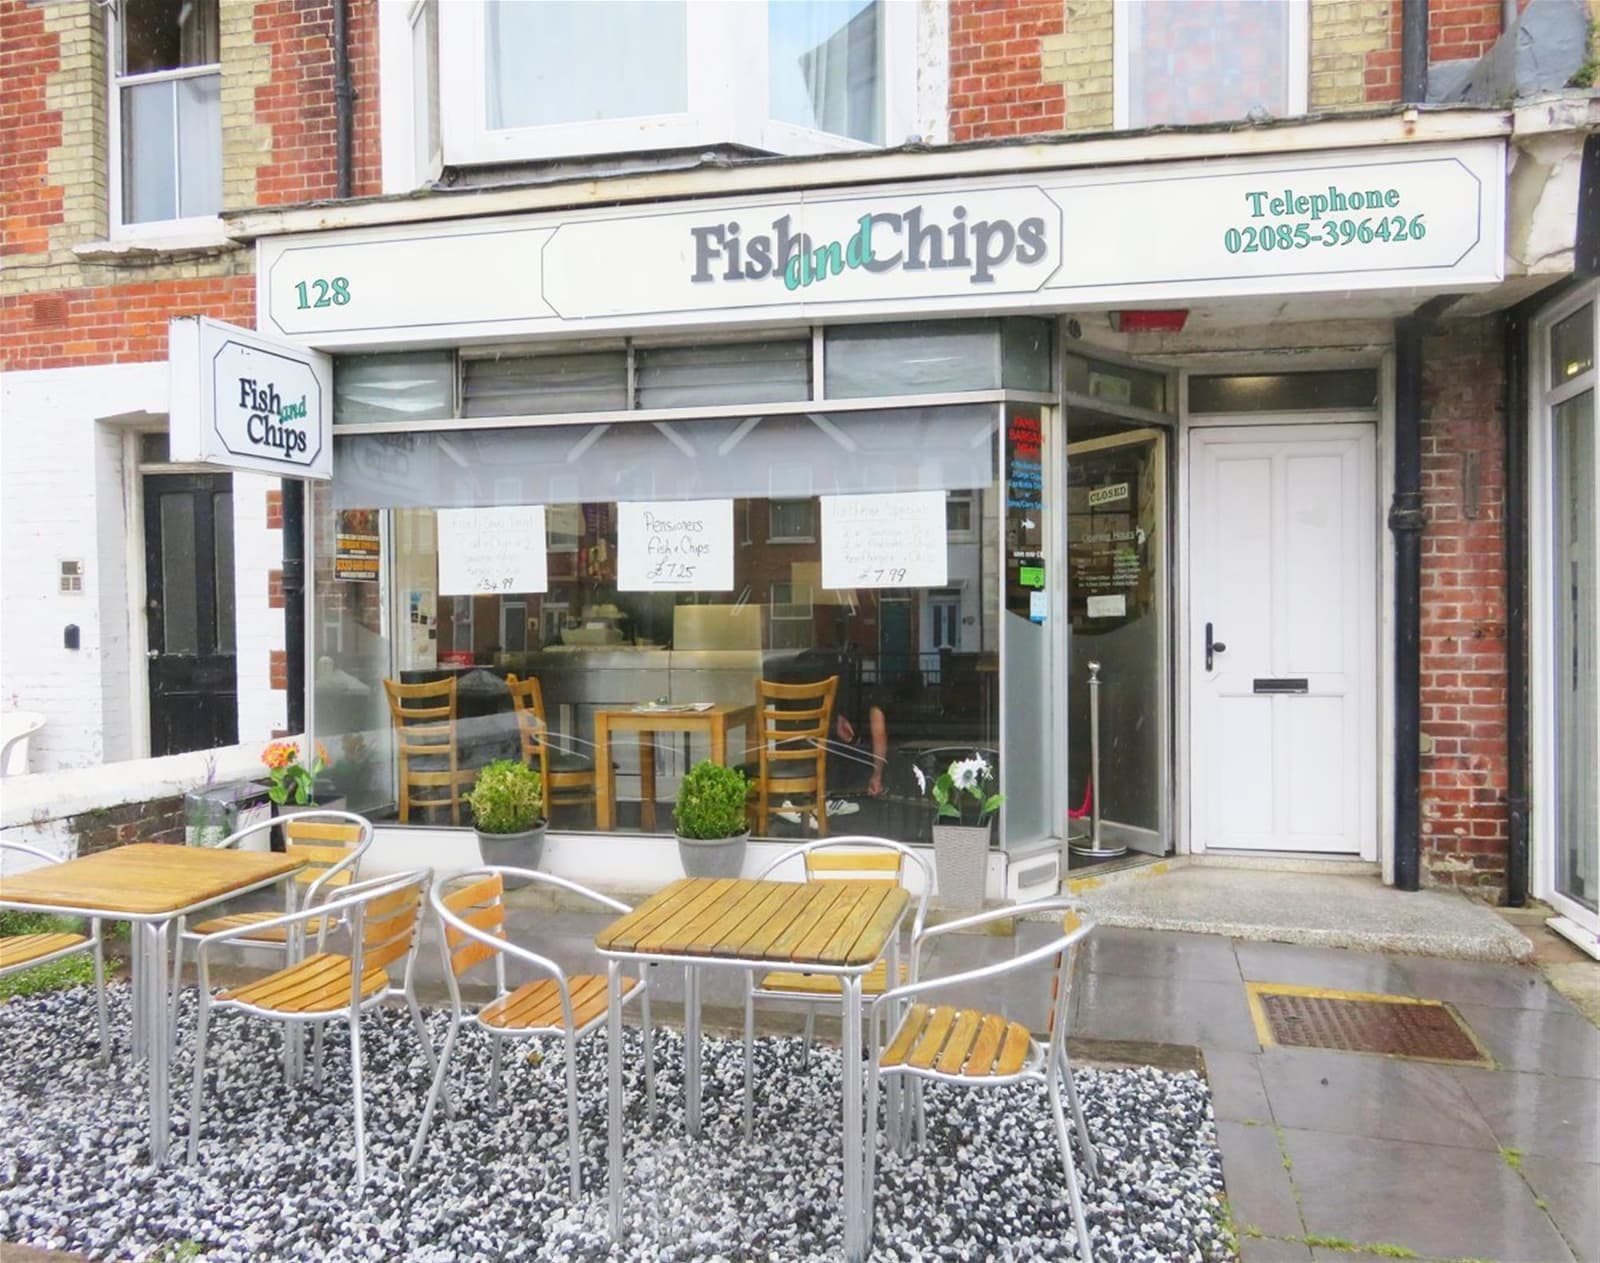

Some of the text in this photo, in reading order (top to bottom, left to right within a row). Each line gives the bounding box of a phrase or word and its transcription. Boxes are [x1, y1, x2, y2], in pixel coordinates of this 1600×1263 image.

[1245, 186, 1400, 220] Telephone
[691, 205, 1047, 291] Fish and Chips
[1224, 214, 1427, 254] 02085-396426
[294, 277, 351, 310] 128
[238, 377, 307, 424] Fish and
[247, 413, 307, 458] Chips
[1089, 485, 1127, 503] CLOSED
[642, 511, 704, 533] Pensioners
[647, 535, 672, 555] Fish
[680, 534, 711, 559] Chips
